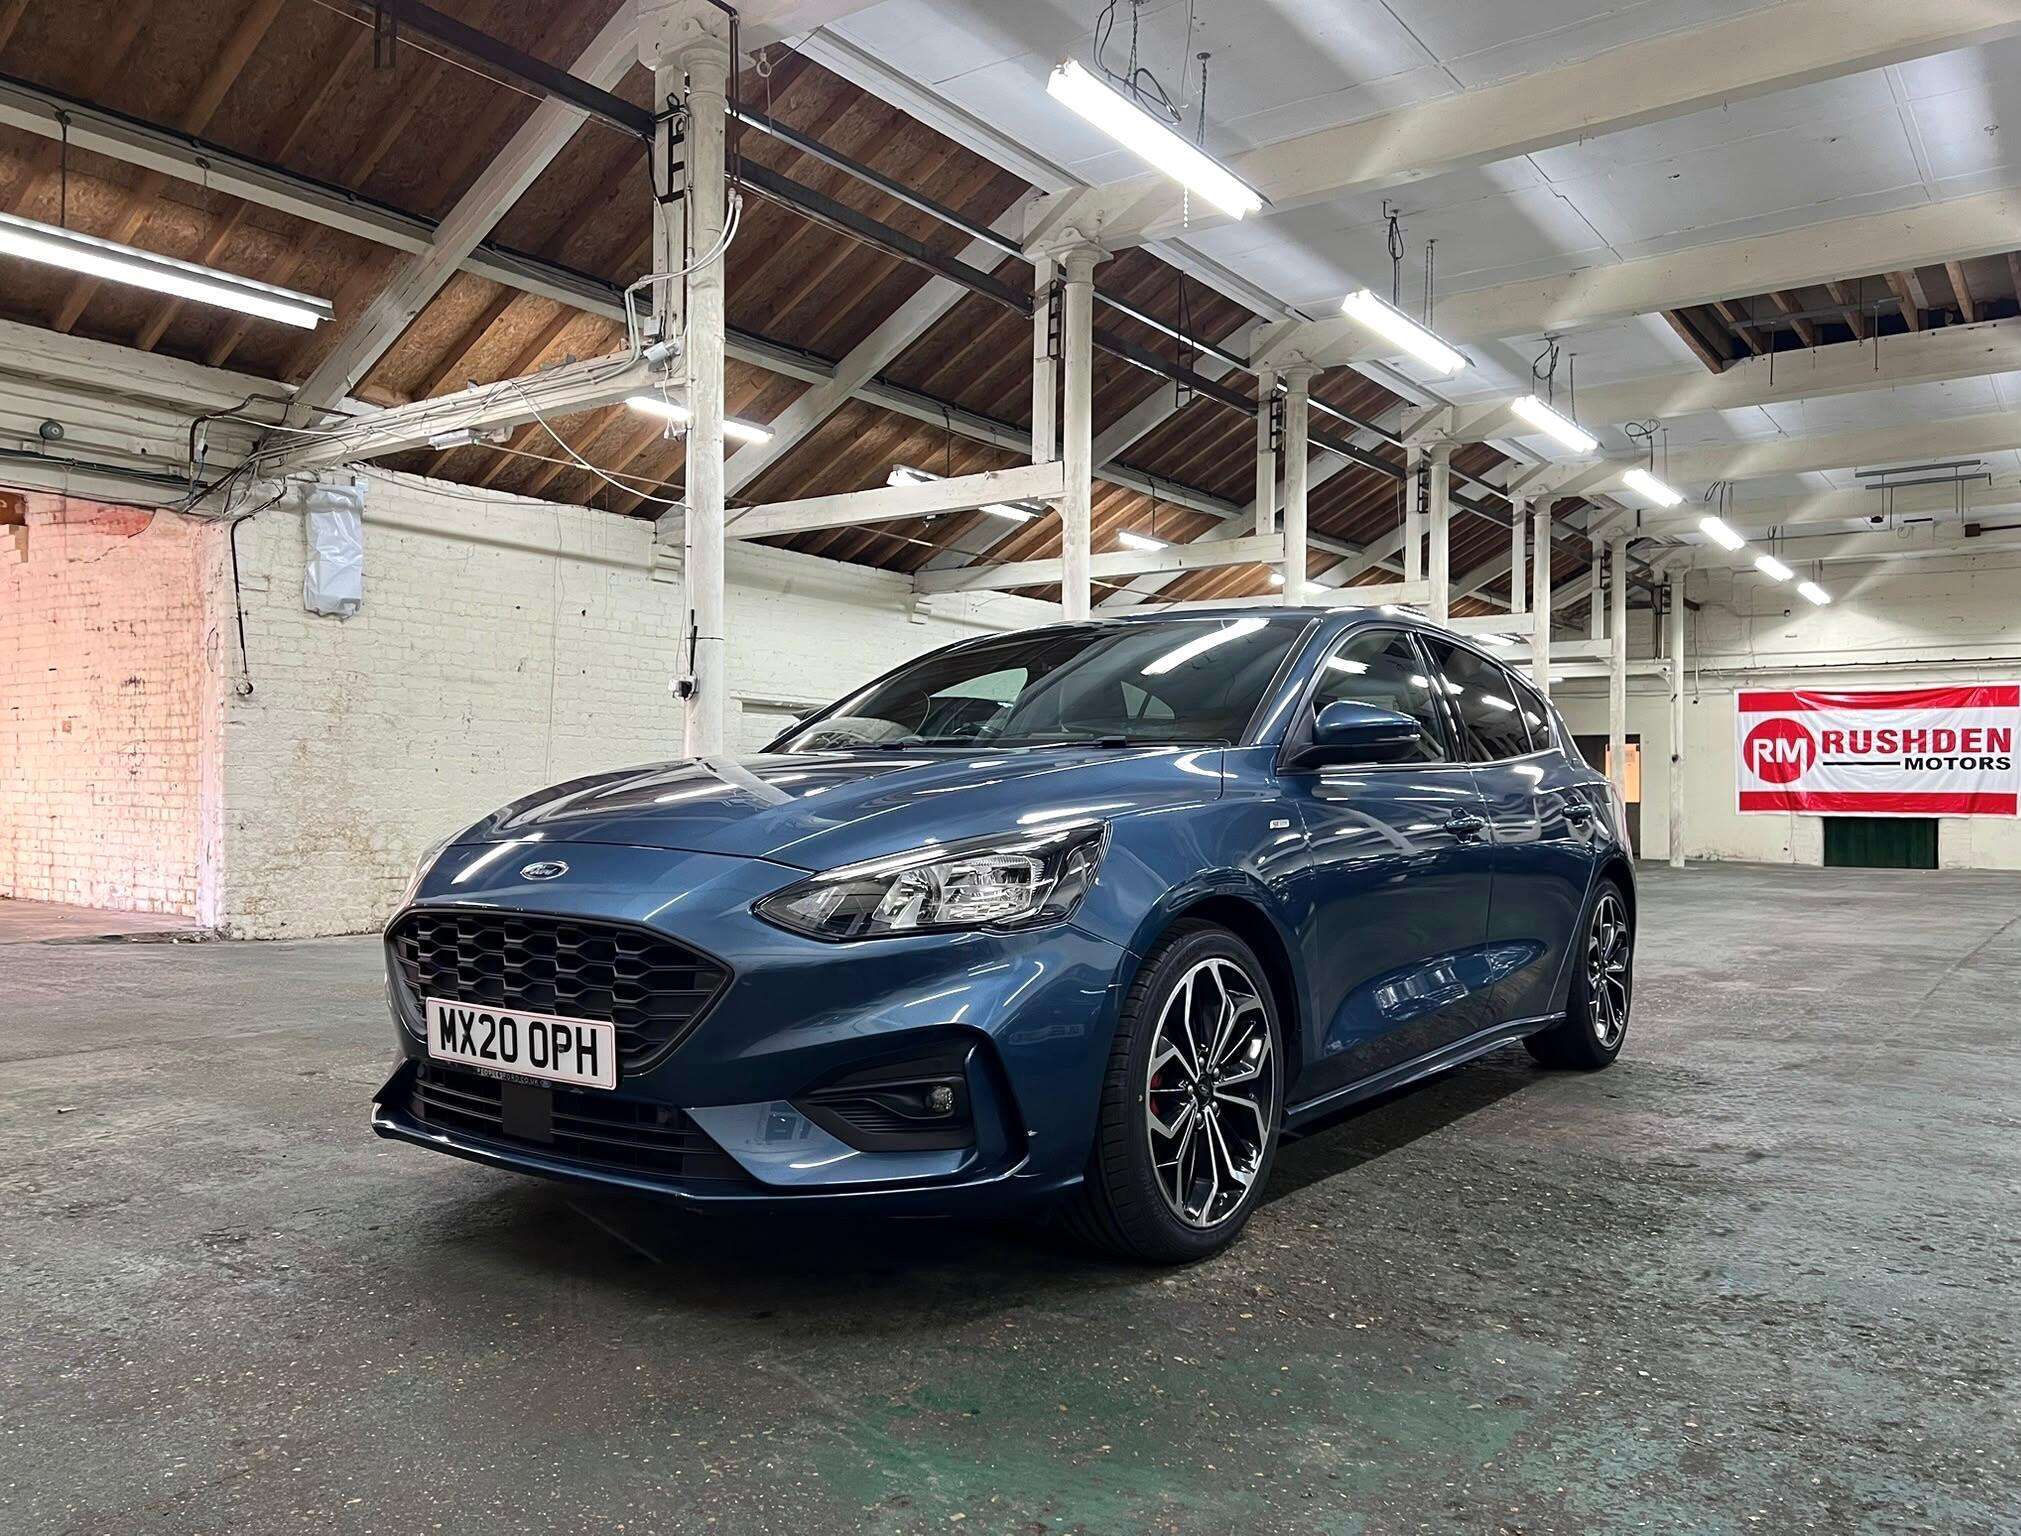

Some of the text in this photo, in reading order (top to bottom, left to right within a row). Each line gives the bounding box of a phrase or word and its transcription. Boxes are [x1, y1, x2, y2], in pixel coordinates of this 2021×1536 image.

[1752, 738, 1808, 770] RM
[1821, 728, 2012, 754] RUSHDEN
[1904, 756, 2012, 771] MOTORS
[438, 1006, 598, 1077] MX20 OPH
